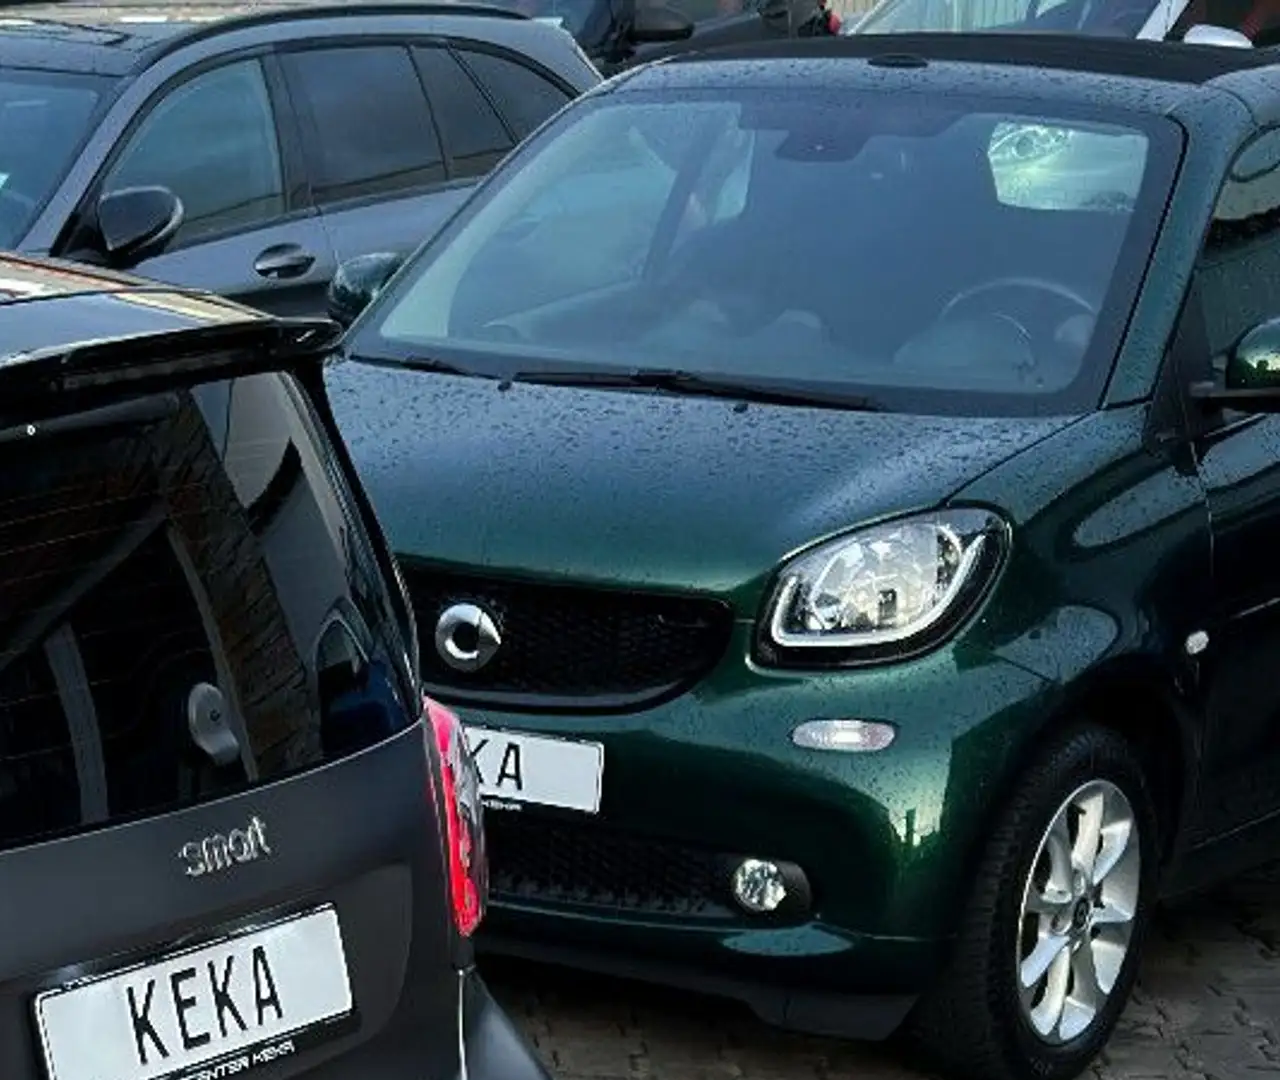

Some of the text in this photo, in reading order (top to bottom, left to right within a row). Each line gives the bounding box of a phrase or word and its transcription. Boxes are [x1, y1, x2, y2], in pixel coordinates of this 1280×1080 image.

[181, 816, 272, 876] smart
[127, 945, 283, 1065] KEKA
[252, 1039, 296, 1065] KEKA
